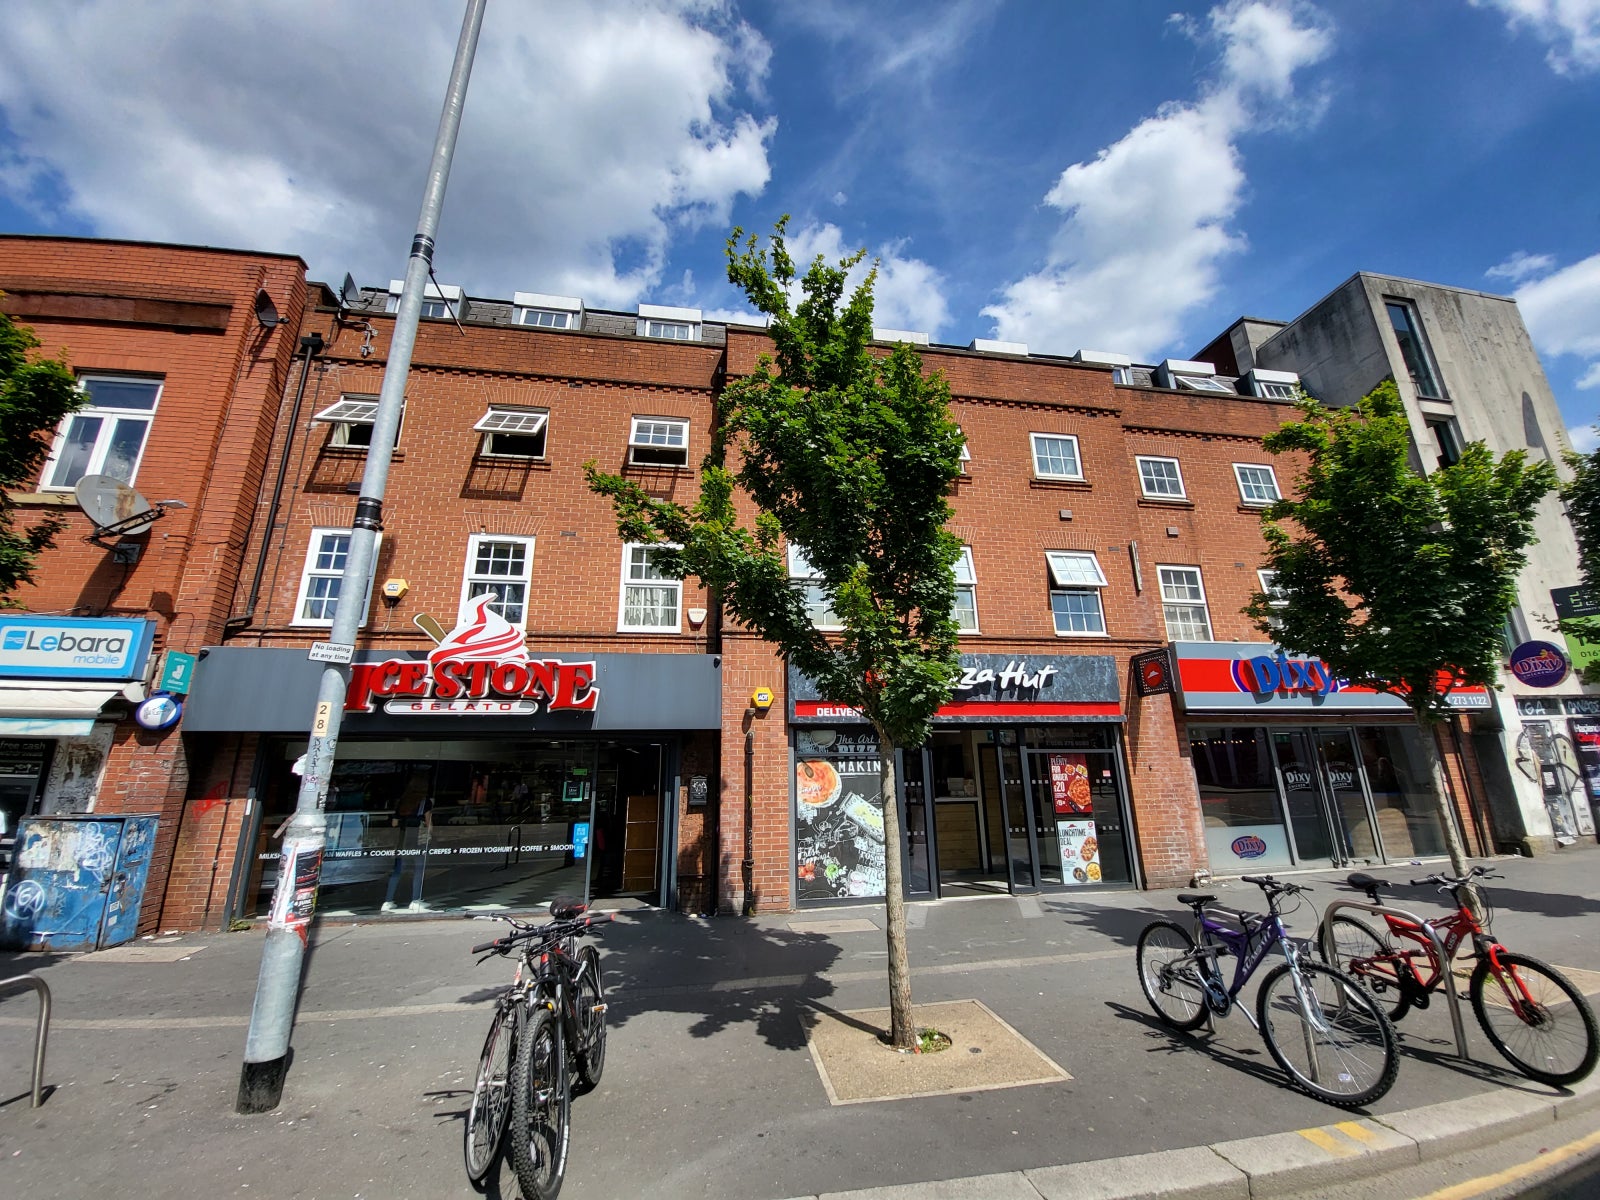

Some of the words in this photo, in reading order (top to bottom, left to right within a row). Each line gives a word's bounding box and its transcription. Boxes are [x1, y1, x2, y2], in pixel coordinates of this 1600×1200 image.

[26, 630, 126, 653] Lebara
[326, 645, 351, 654] loading
[73, 655, 121, 665] mobile
[1520, 658, 1559, 673] Dixy
[999, 660, 1059, 690] Hut
[1250, 649, 1333, 697] Dixy
[1452, 695, 1468, 705] 273
[1469, 695, 1488, 705] 1122
[411, 702, 512, 712] GELATO
[816, 707, 866, 717] DELIVER
[836, 734, 854, 746] The
[857, 733, 875, 744] Art
[1050, 757, 1068, 766] PLENTY
[1051, 765, 1061, 774] FOR
[1052, 773, 1069, 782] UNDER
[1285, 770, 1311, 784] Dixy
[1053, 781, 1066, 792] £20
[1060, 829, 1087, 837] LUNCHTIME
[1060, 837, 1072, 846] DEAL
[1238, 840, 1261, 852] Dixy
[335, 850, 362, 858] WAFFLES
[370, 849, 396, 857] COOKIE
[428, 848, 452, 856] CREPES
[459, 847, 483, 855] FROZEN
[484, 845, 513, 854] YOGHURT
